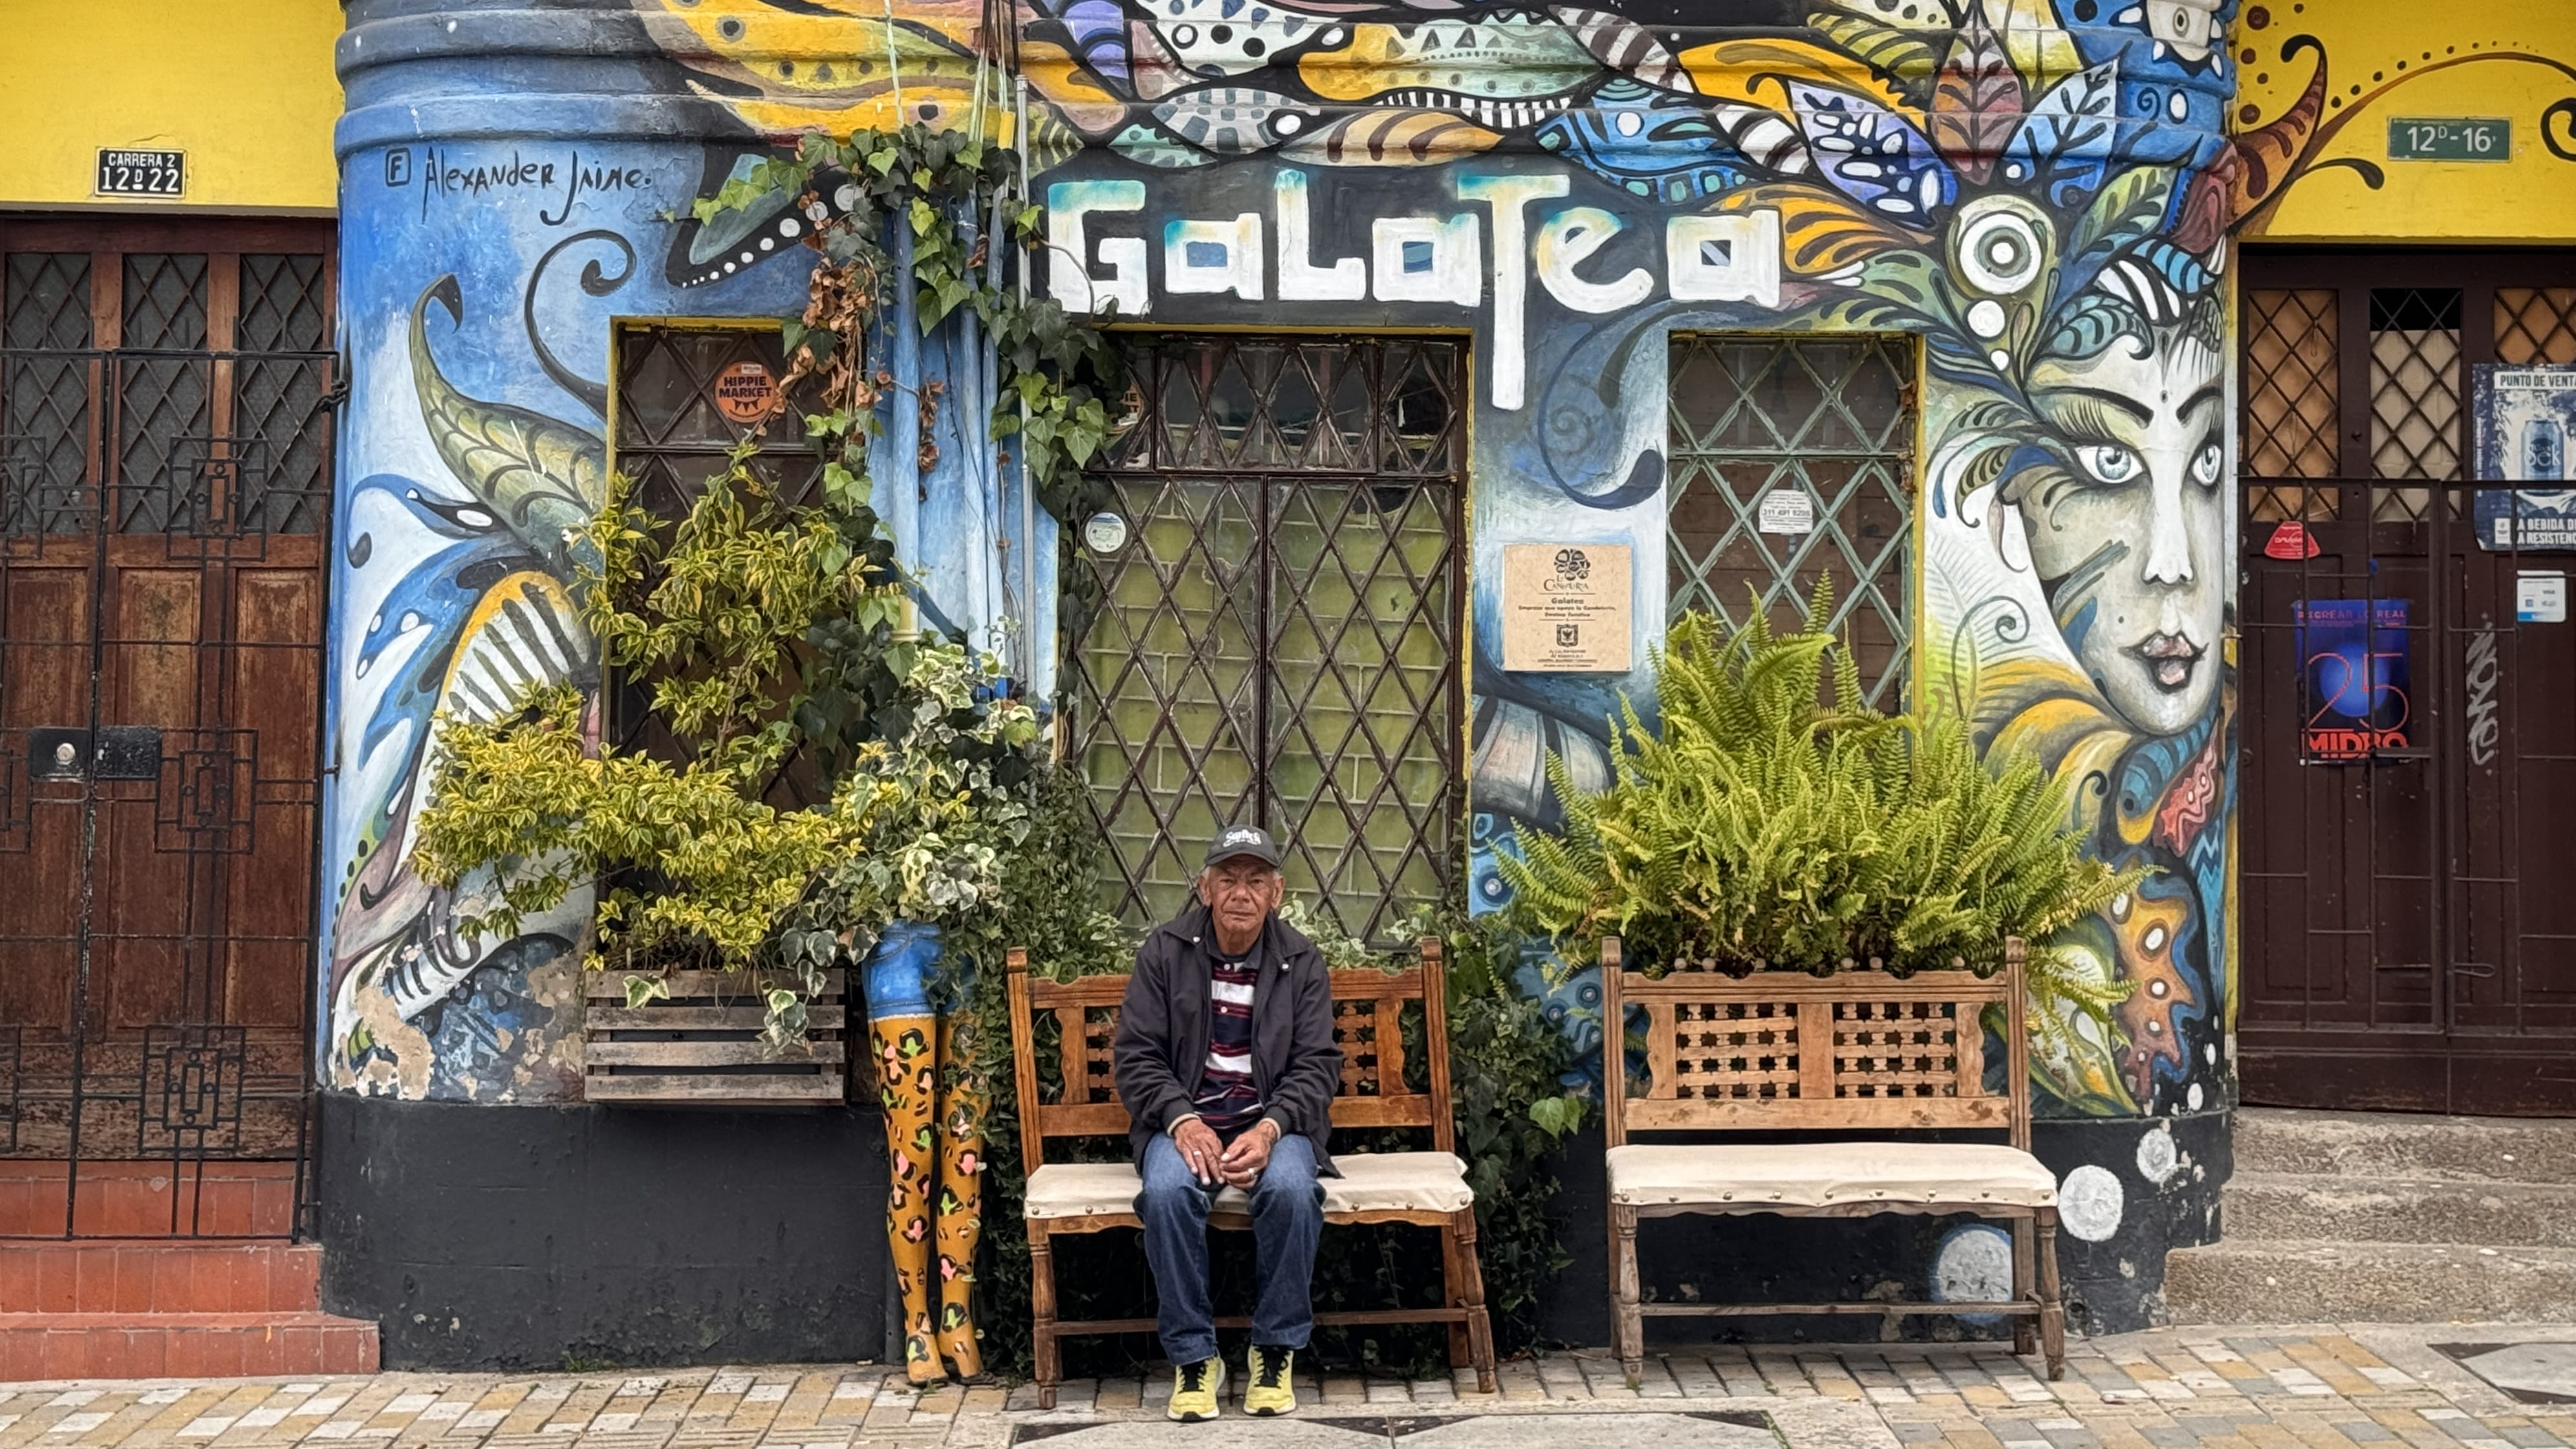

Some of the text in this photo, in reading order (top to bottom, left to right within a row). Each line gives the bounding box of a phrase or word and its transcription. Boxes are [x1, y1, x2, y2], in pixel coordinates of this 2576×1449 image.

[108, 153, 175, 168] CARRERA 2
[724, 376, 767, 387] HIPPIE
[2500, 375, 2576, 387] PUNTO DE VENT
[719, 387, 772, 398] MARKET
[2527, 518, 2565, 530] BEBIDA
[2568, 518, 2576, 530] D
[2302, 652, 2410, 734] 25
